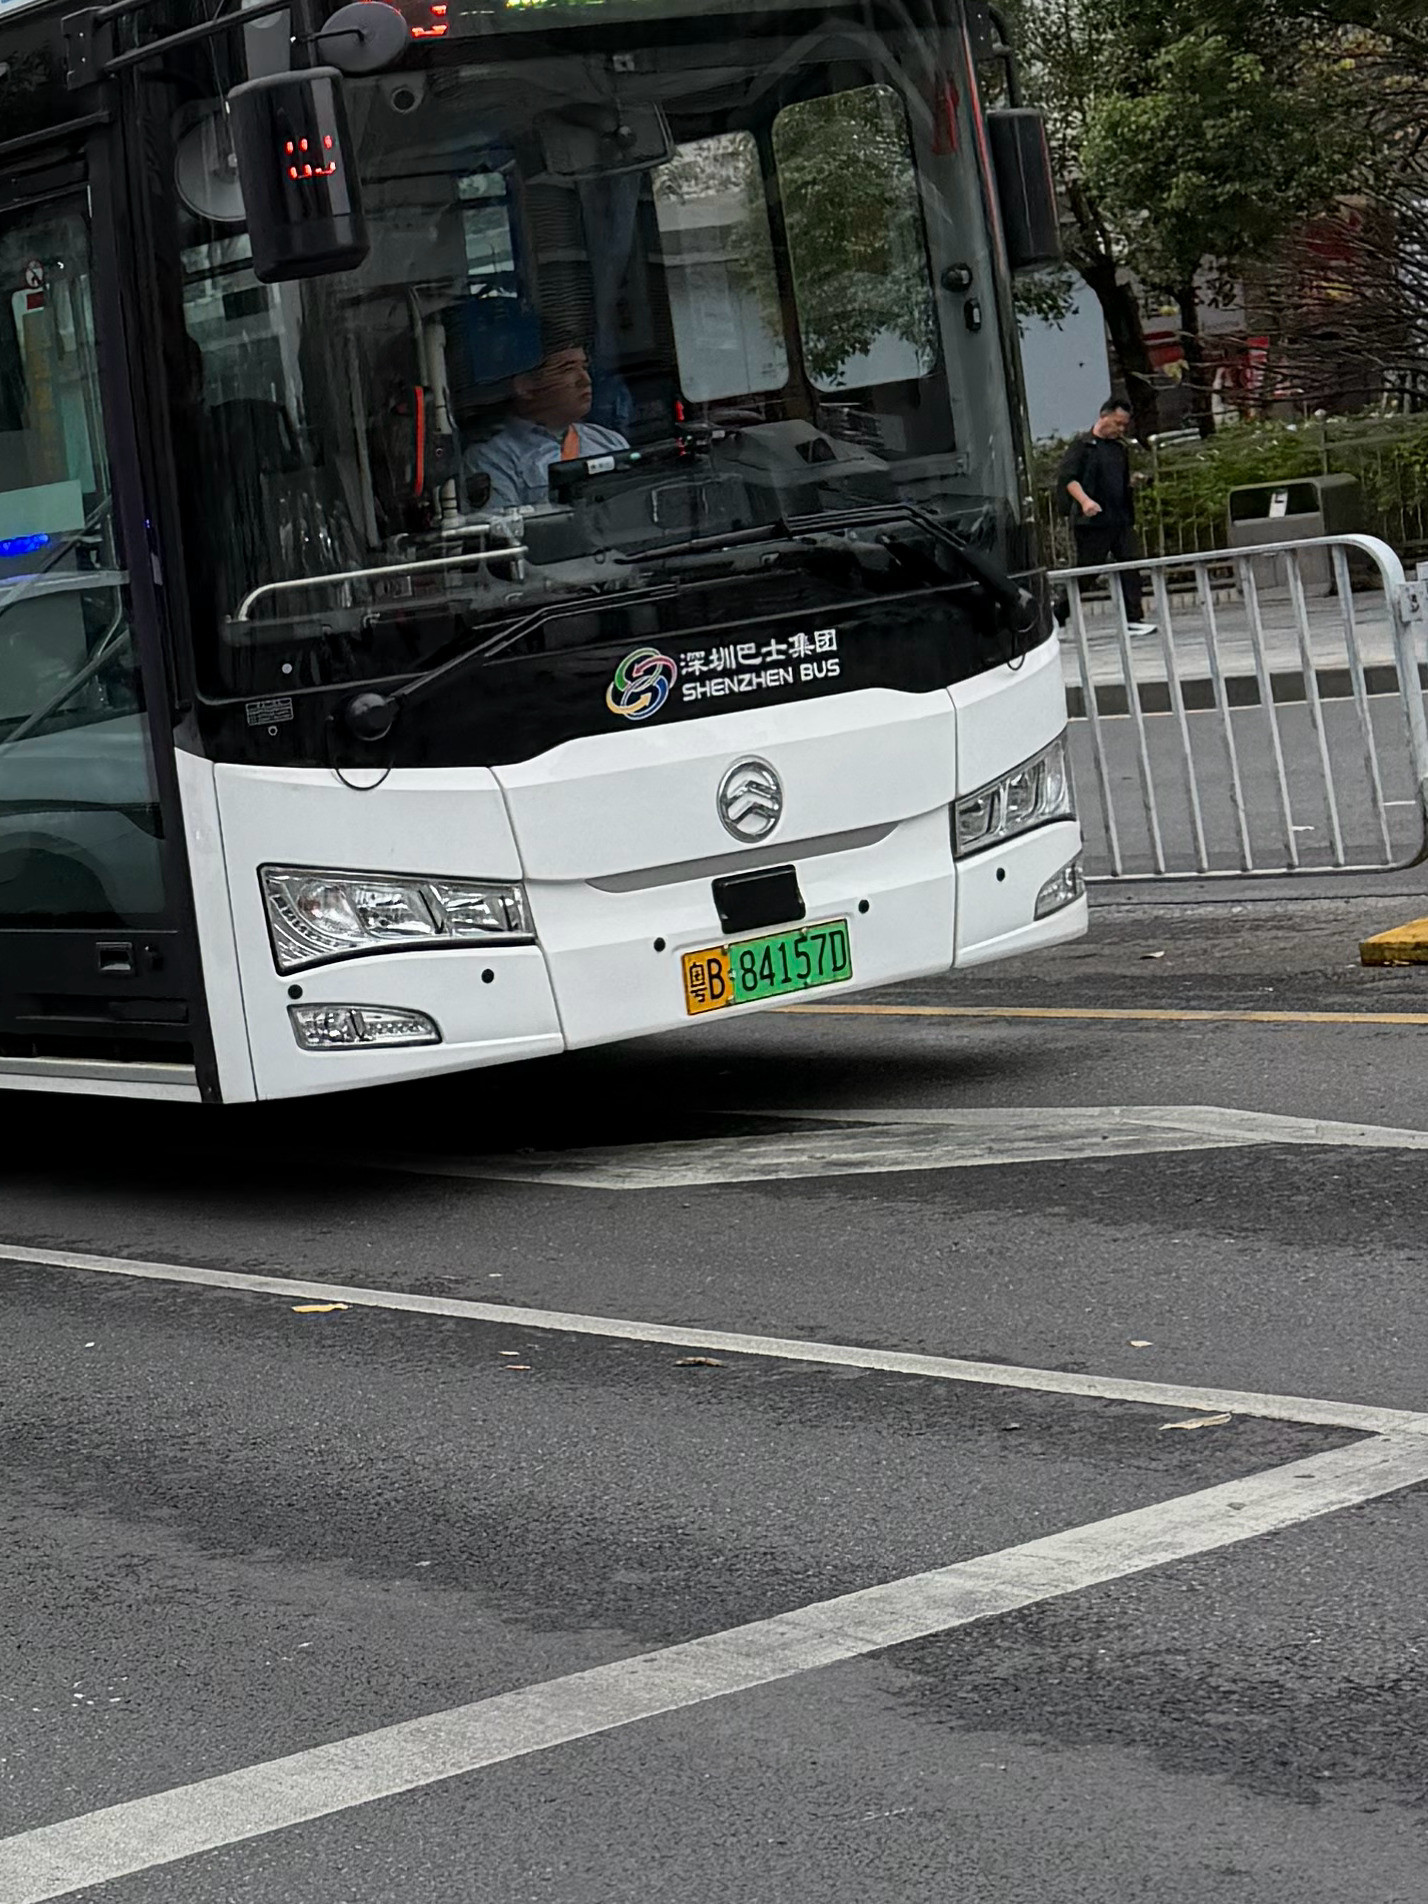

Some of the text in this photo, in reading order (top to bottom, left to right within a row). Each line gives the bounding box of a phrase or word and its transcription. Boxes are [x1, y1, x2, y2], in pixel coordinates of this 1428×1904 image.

[679, 628, 839, 676] 深圳巴士集团
[681, 658, 841, 702] SHENZHEN BUS
